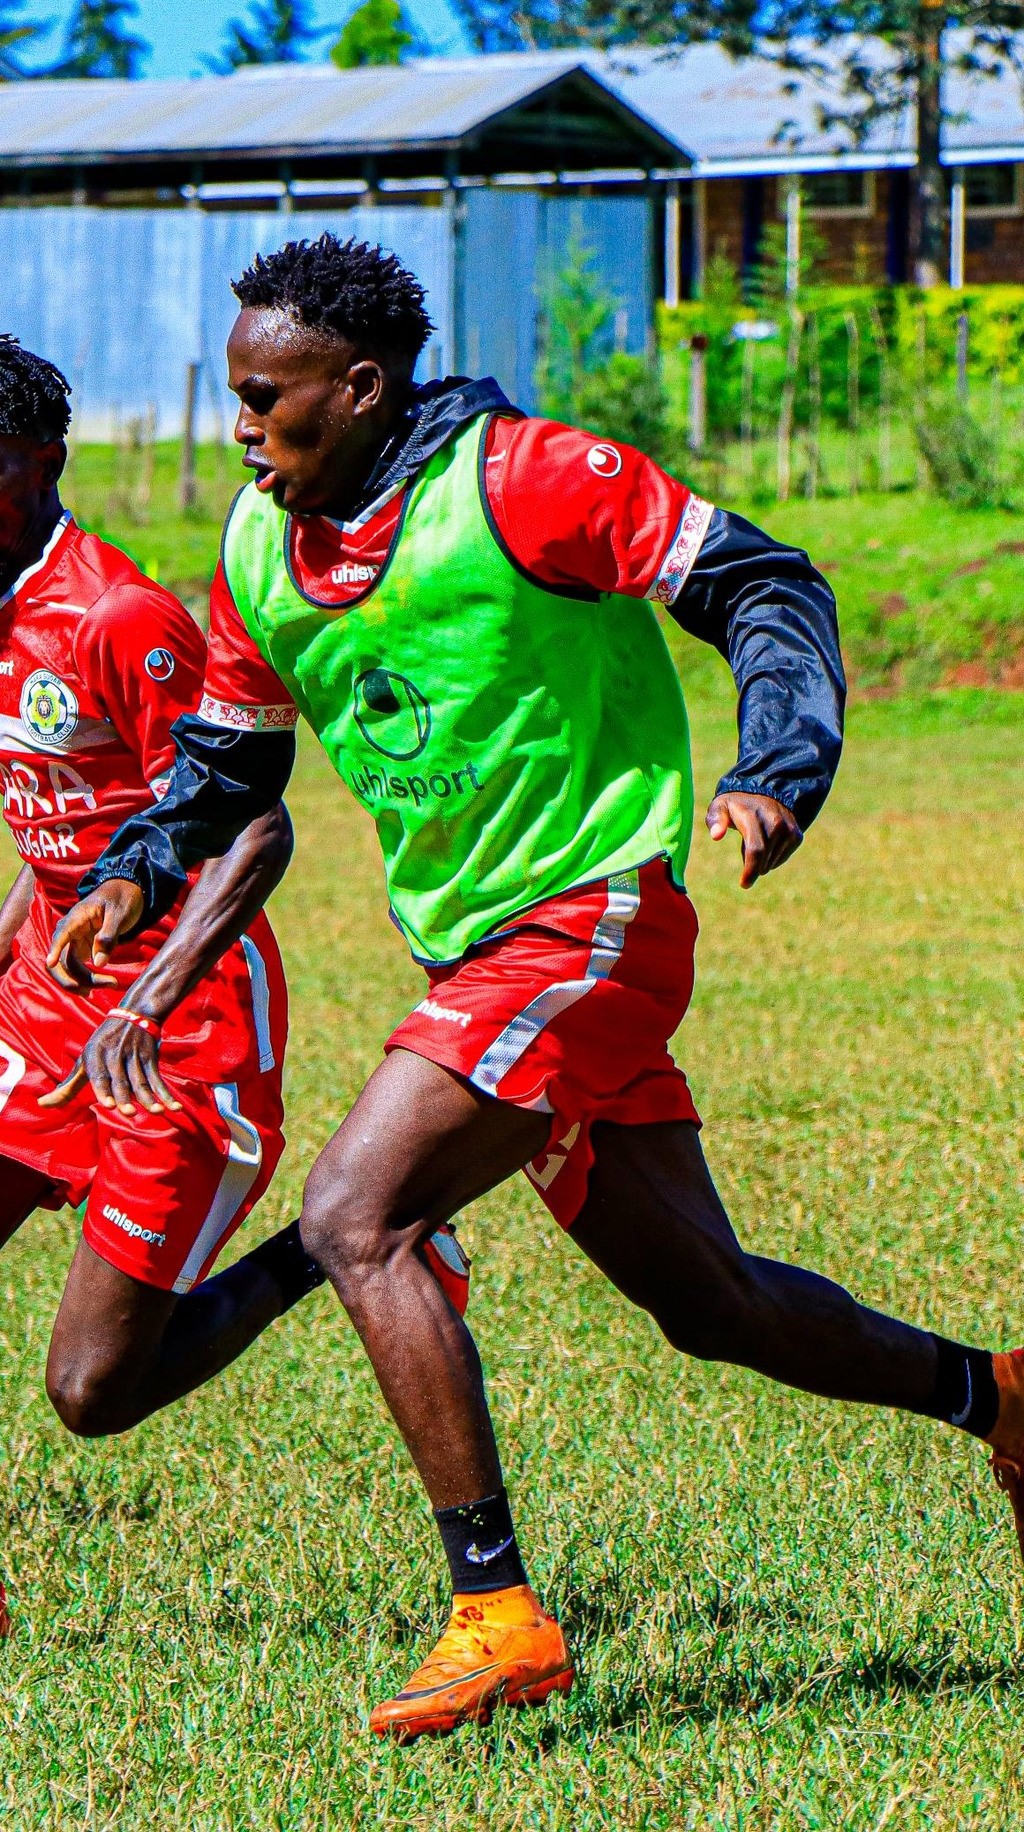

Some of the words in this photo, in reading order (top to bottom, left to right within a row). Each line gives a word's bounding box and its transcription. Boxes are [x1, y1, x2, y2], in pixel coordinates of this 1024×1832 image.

[57, 722, 72, 740] CLUB
[351, 761, 484, 806] uhlsport
[102, 1204, 167, 1248] uhlsport
